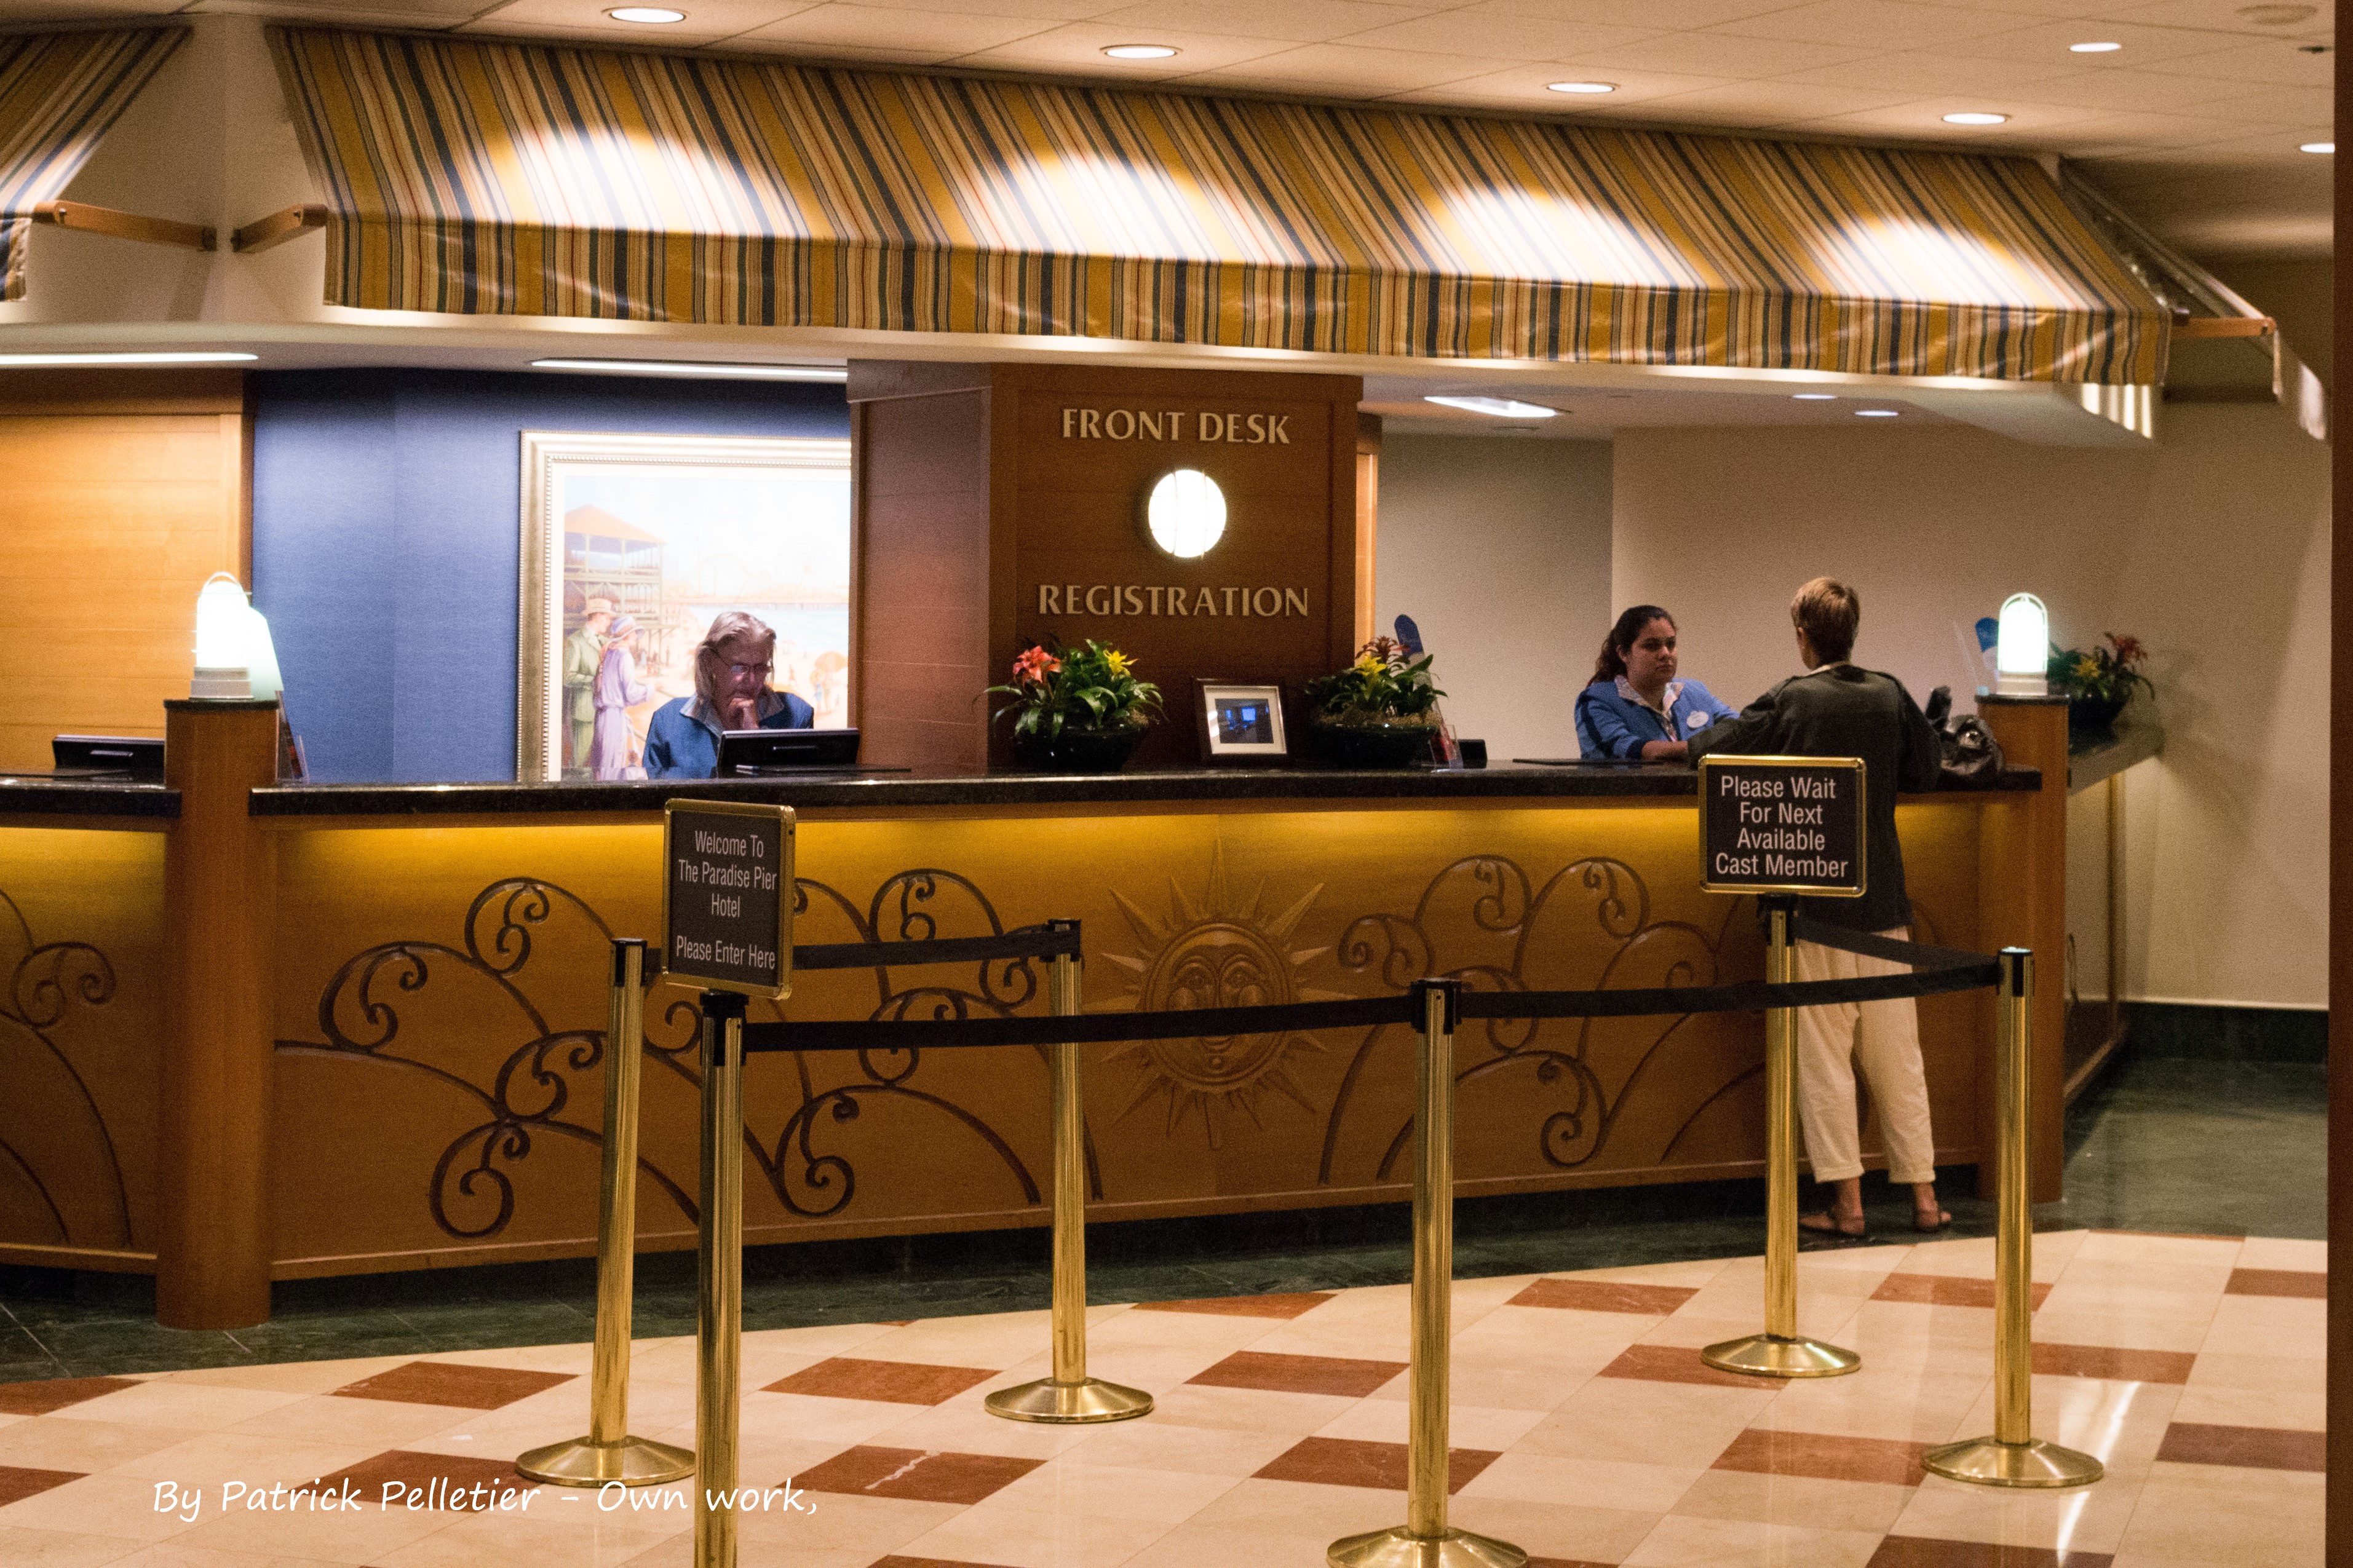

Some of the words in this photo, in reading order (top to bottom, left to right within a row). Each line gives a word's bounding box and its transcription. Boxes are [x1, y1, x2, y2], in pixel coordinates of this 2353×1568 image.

[1062, 408, 1185, 441] FRONT
[1199, 412, 1290, 444] DESK
[1039, 584, 1308, 616] REGISTRATION
[1721, 775, 1784, 798] Please
[1791, 777, 1836, 799] Wait
[1740, 802, 1772, 823] For
[1779, 802, 1823, 825] Next
[695, 830, 746, 857] Welcome
[750, 834, 764, 858] To
[1737, 828, 1825, 850] Available
[678, 859, 698, 883] The
[702, 861, 749, 888] Paradise
[754, 866, 777, 890] Pier
[1716, 852, 1758, 875] Cast
[1766, 854, 1848, 877] Member
[711, 893, 740, 917] Hotel
[677, 935, 712, 961] Please
[715, 940, 745, 965] Enter
[748, 944, 775, 970] Here
